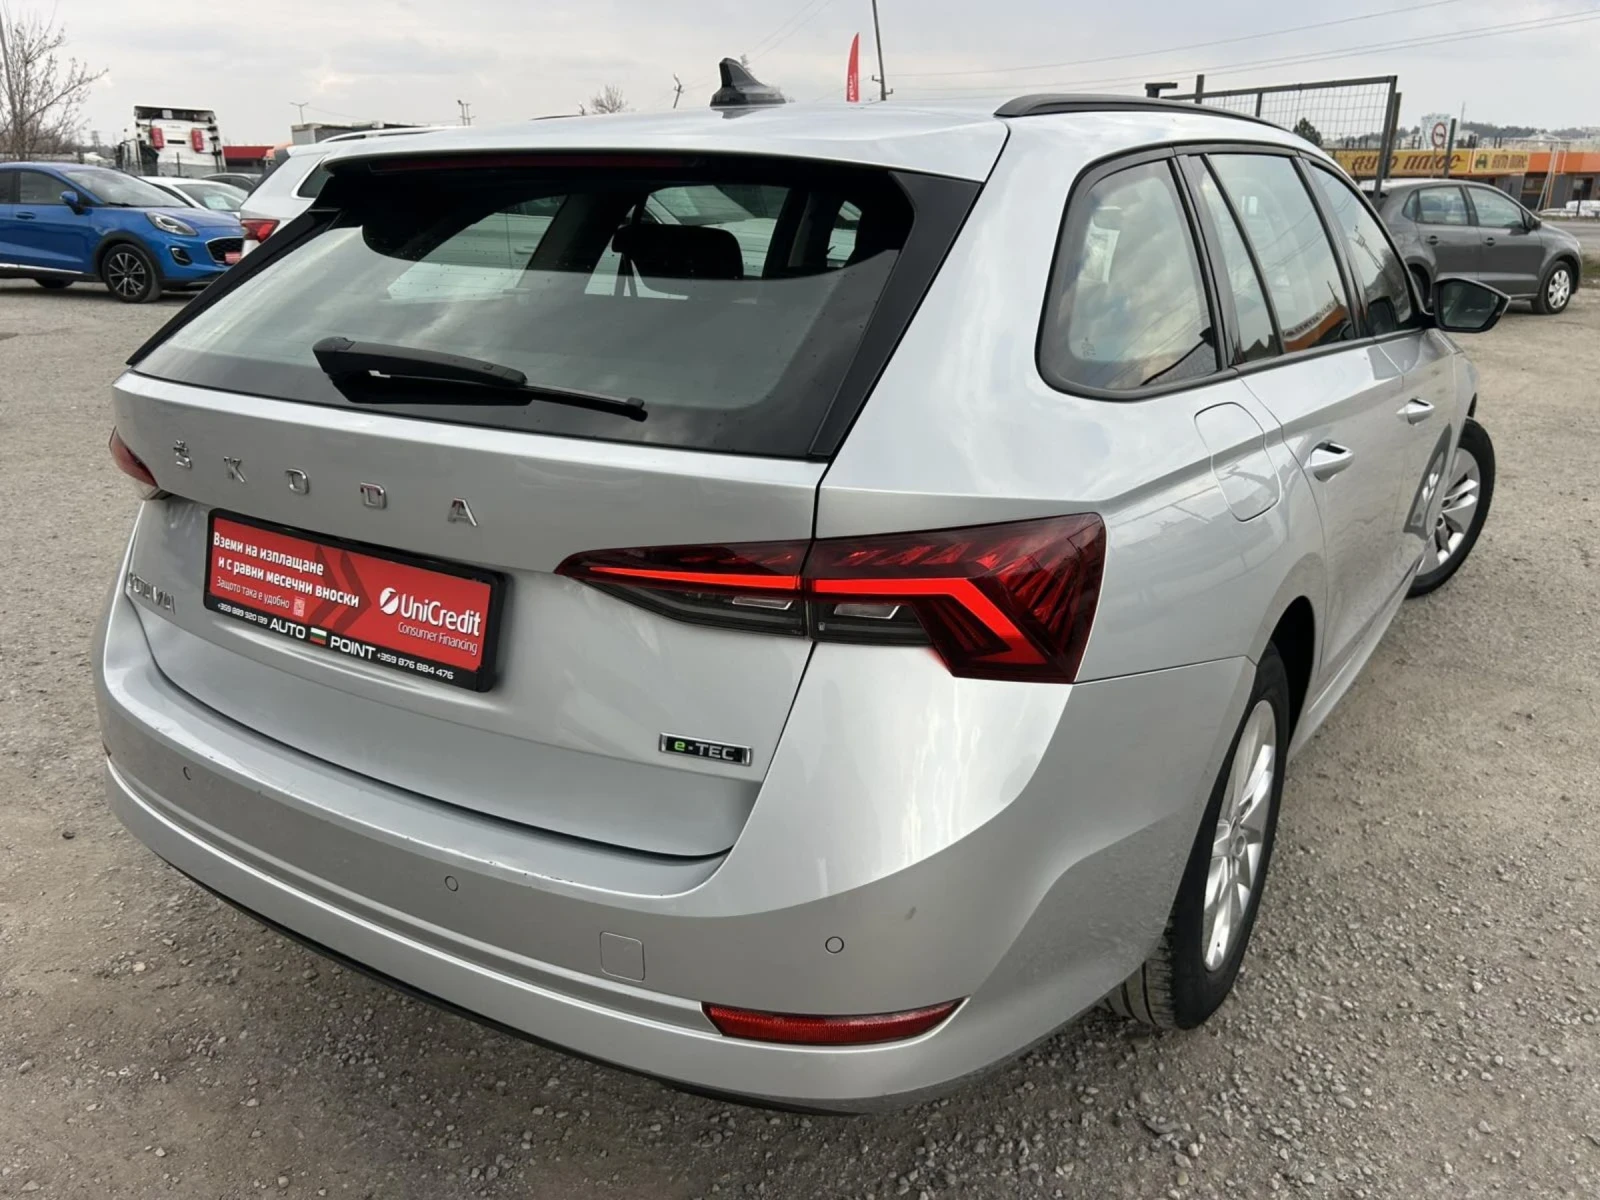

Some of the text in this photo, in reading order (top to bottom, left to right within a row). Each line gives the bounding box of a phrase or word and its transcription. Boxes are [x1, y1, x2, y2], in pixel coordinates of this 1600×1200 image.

[213, 532, 324, 576] Вземи на изплащане
[216, 576, 290, 609] Защото така е удобно
[218, 556, 360, 608] и с равни месечни вноски
[400, 593, 481, 637] UniCredit
[269, 617, 306, 639] AUTO
[330, 635, 376, 660] POINT
[376, 652, 397, 665] +359
[398, 656, 415, 669] 876
[416, 662, 435, 675] 884
[435, 667, 455, 680] 476
[398, 621, 478, 657] Consumer Financing
[673, 741, 736, 761] e-TEC
